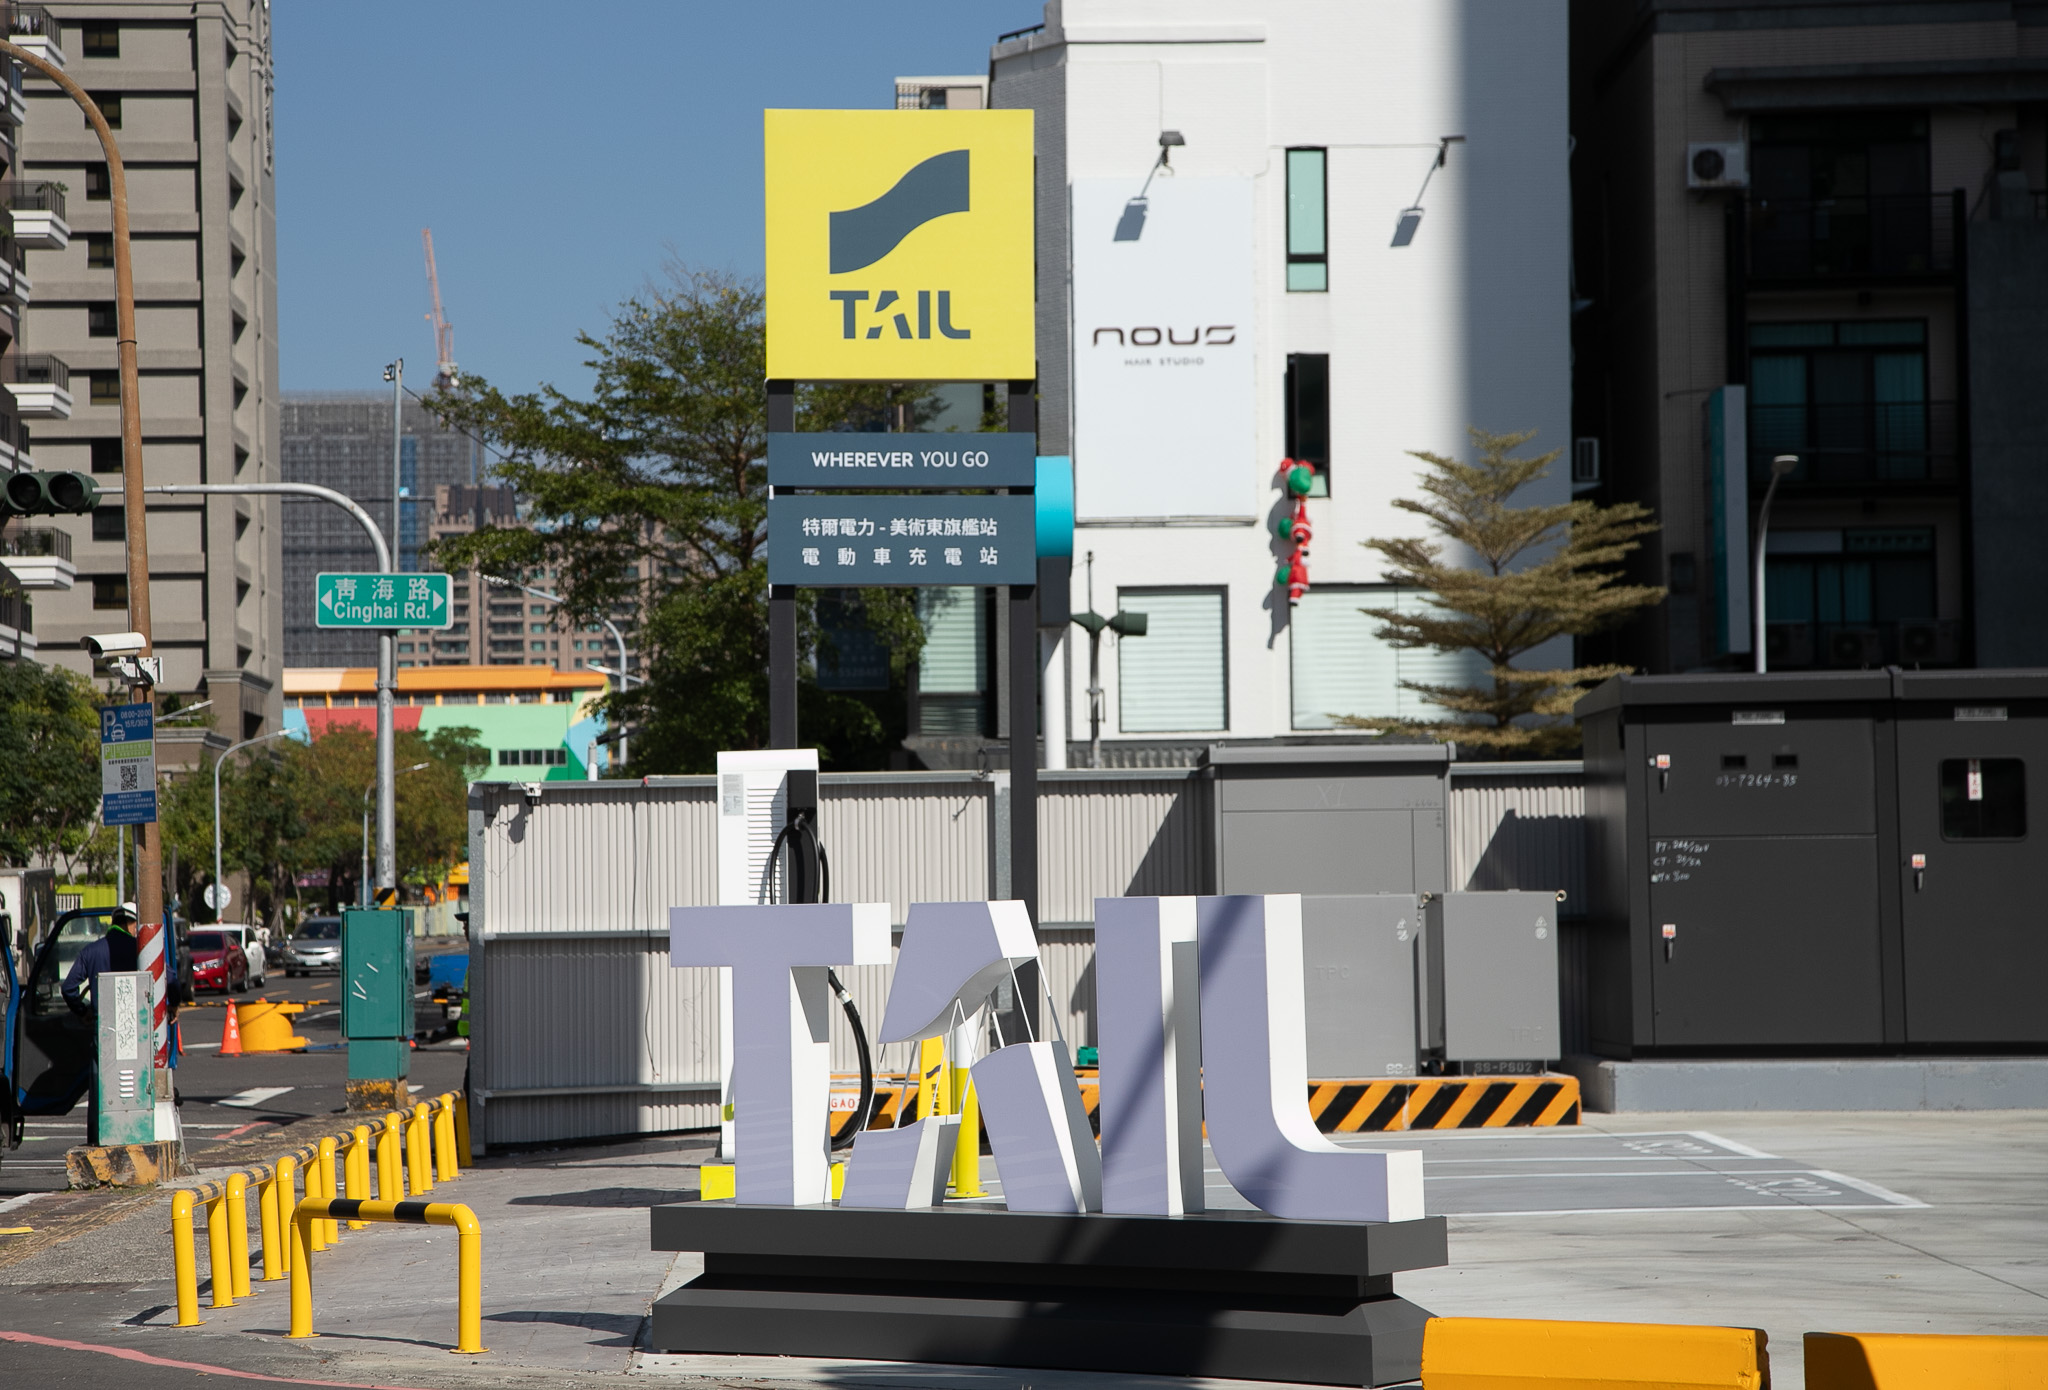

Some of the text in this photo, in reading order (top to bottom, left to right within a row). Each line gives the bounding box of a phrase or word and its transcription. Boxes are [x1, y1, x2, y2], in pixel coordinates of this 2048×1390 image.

[830, 290, 971, 339] TAIL
[1124, 357, 1204, 366] HAIR STUDIO
[811, 451, 989, 467] WHEREVER YOU GO
[802, 518, 875, 537] 特爾電力
[890, 518, 998, 537] 美術東旗艦站
[335, 577, 431, 601] 青海路
[334, 602, 430, 623] Cinghai Rd.
[670, 893, 1424, 1222] TAIL
